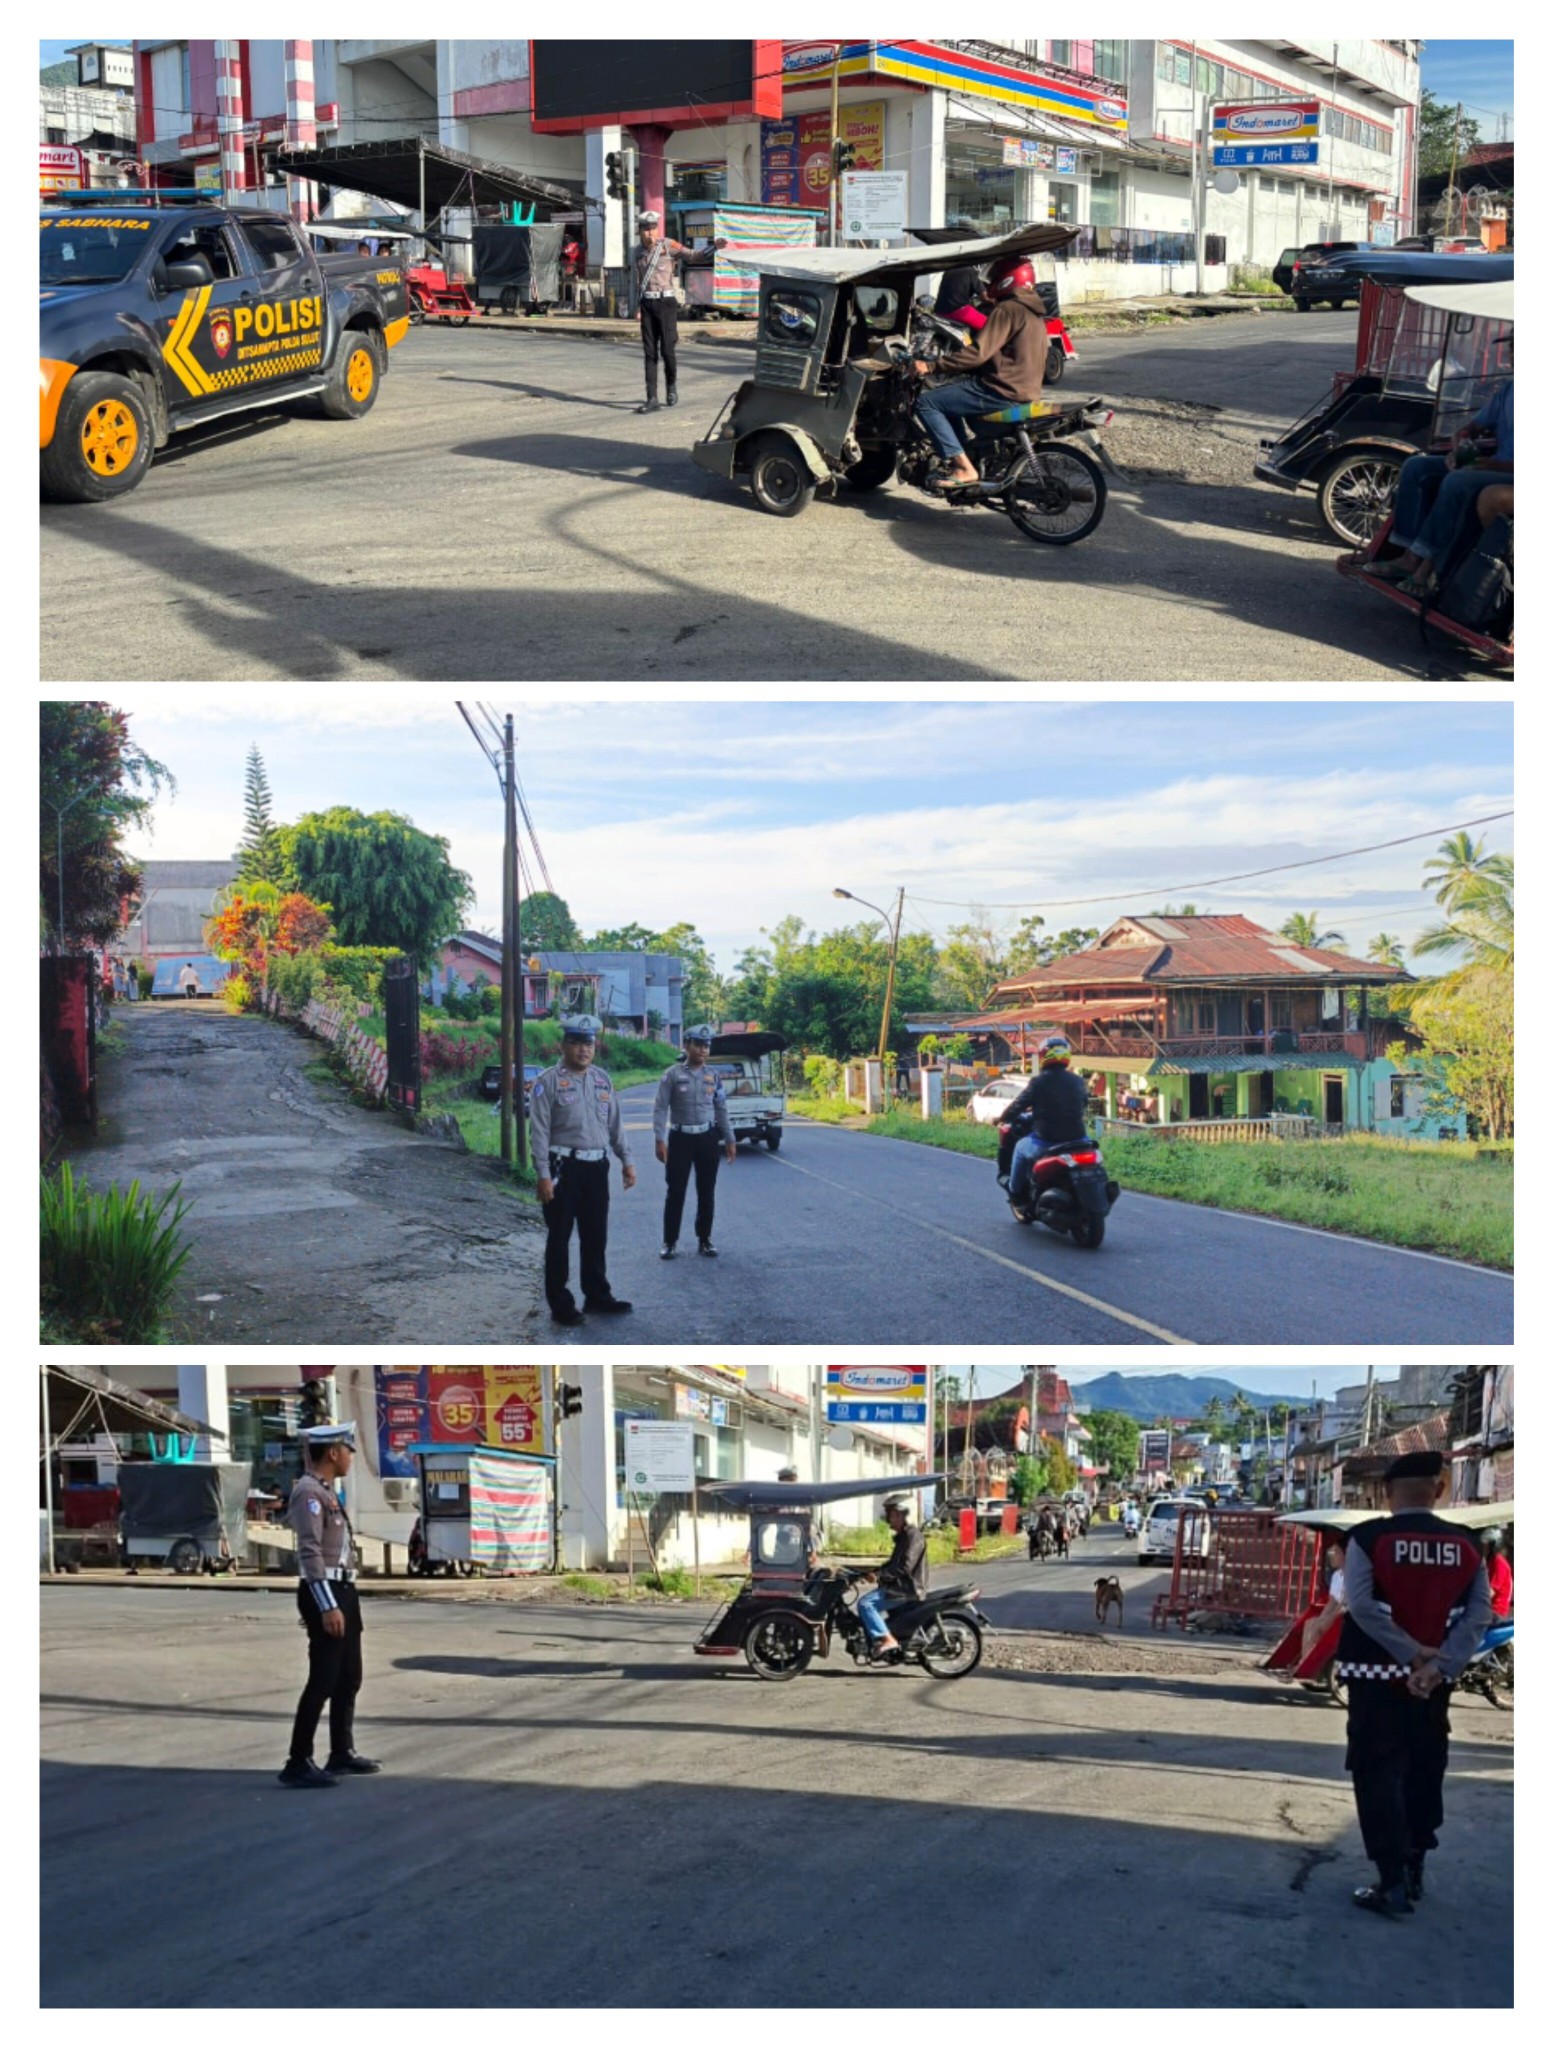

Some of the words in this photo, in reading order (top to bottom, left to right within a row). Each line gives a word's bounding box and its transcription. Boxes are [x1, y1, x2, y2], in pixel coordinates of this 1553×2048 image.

[1232, 114, 1298, 129] Indomaret
[808, 167, 831, 187] 35
[55, 218, 150, 230] SABHARA
[233, 296, 323, 342] POLISI
[845, 1371, 908, 1385] Indomaret
[444, 1403, 474, 1425] 35
[1395, 1540, 1461, 1567] POLISI
